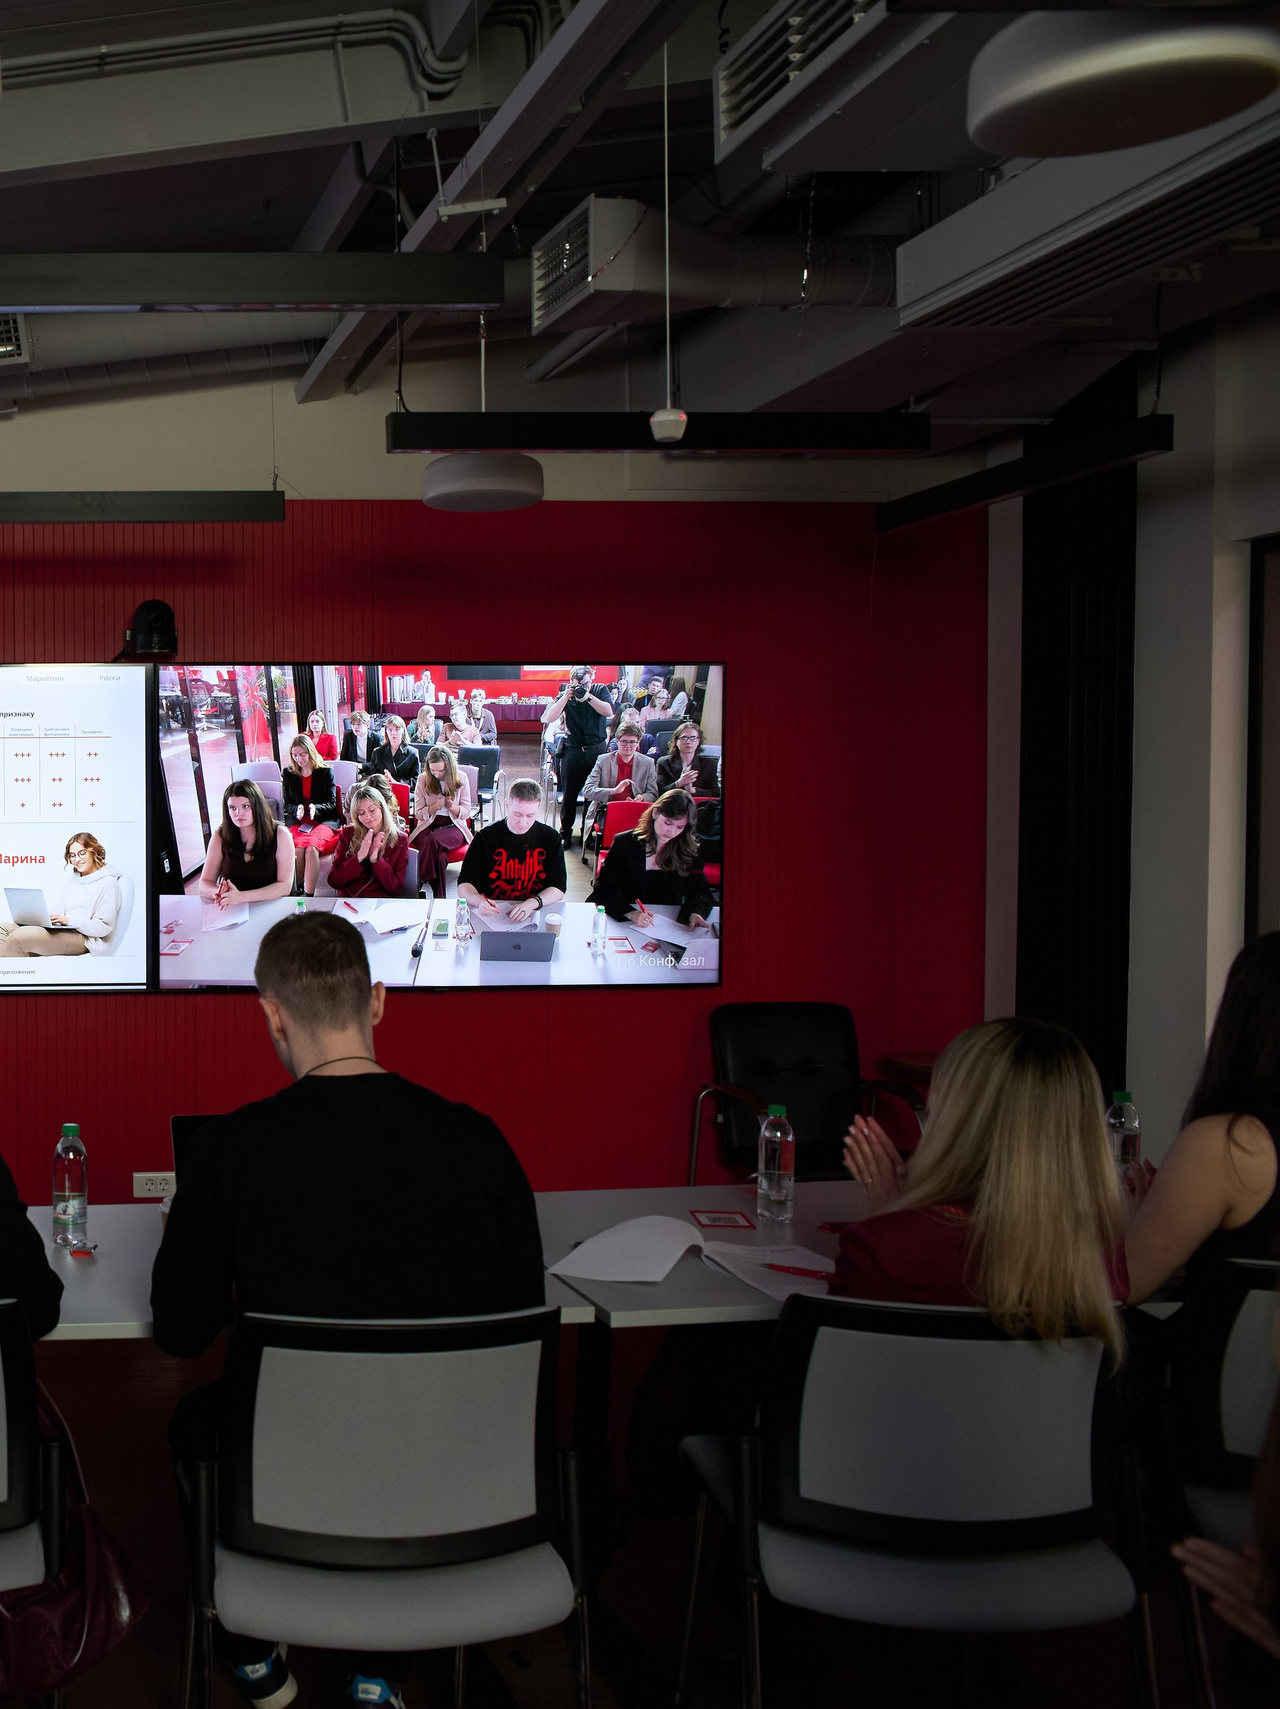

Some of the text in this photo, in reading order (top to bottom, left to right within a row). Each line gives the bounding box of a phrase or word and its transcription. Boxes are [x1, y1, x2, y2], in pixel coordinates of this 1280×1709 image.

[609, 950, 705, 968] СПб Конф. зал
